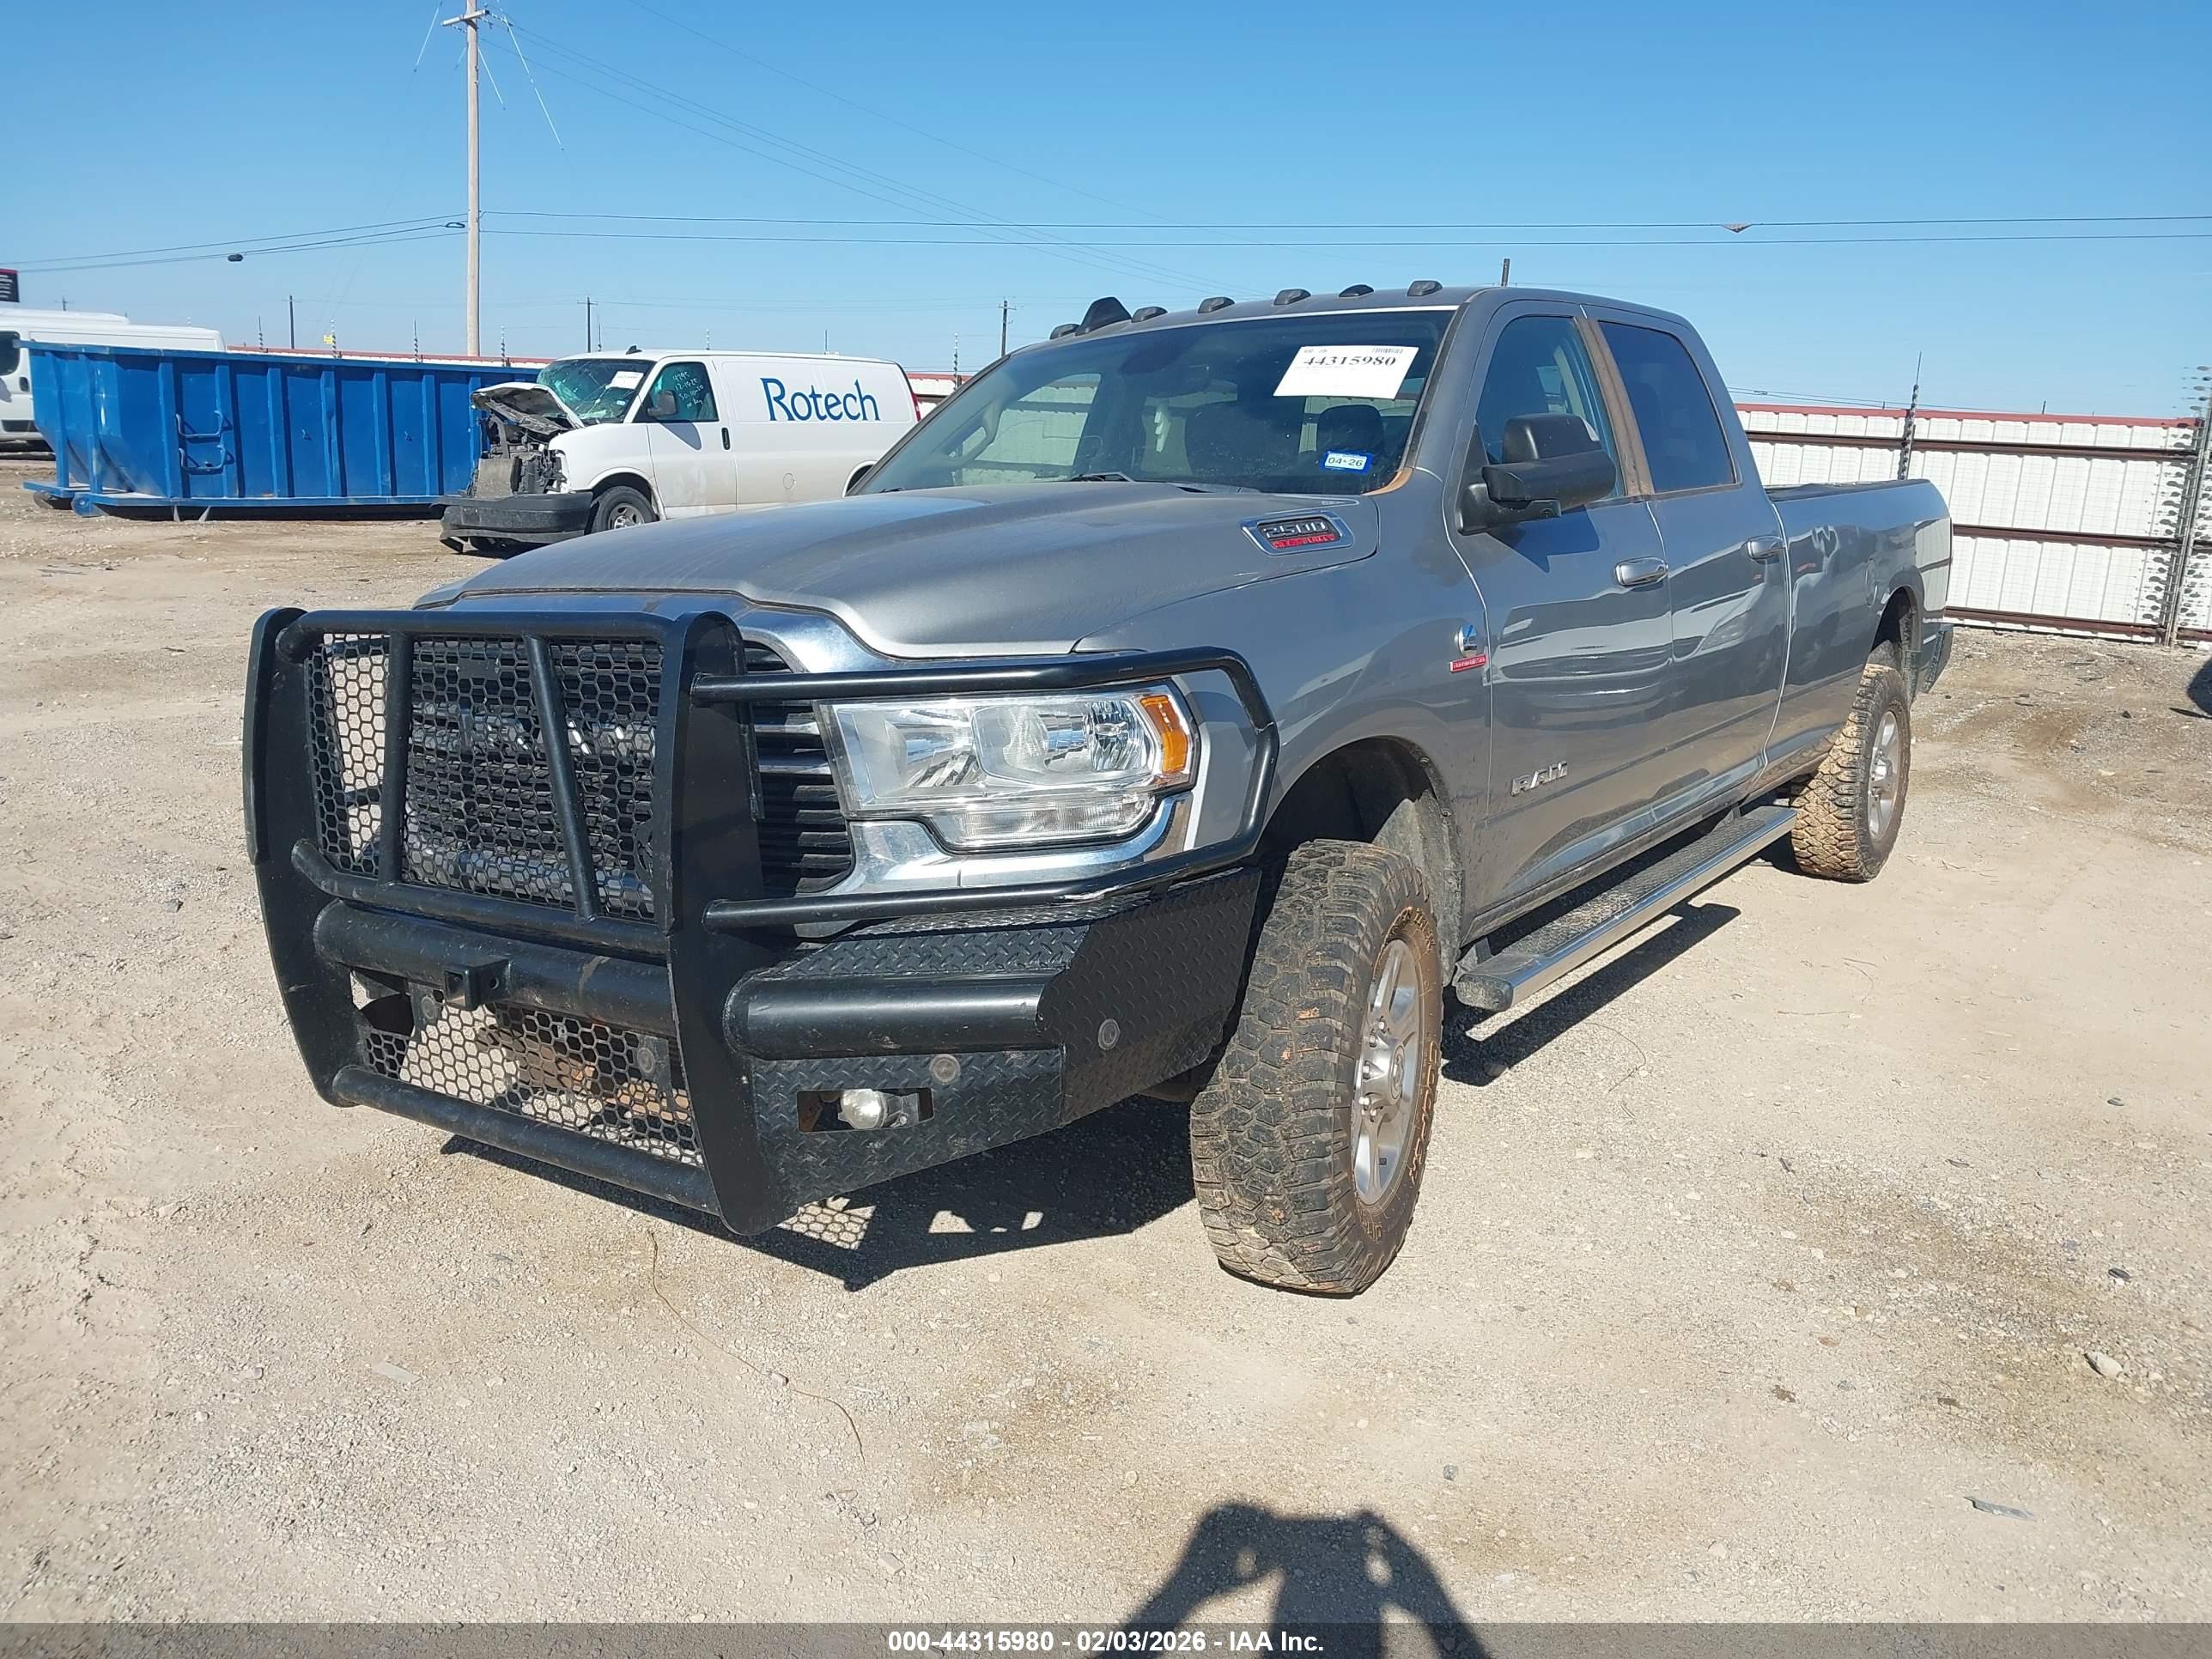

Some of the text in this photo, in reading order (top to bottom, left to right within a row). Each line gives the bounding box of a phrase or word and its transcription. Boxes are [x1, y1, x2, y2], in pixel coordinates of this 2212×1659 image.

[1303, 356, 1397, 367] 44315980
[759, 377, 881, 422] Rotech
[1262, 521, 1328, 538] 2500
[1510, 760, 1568, 797] RAM
